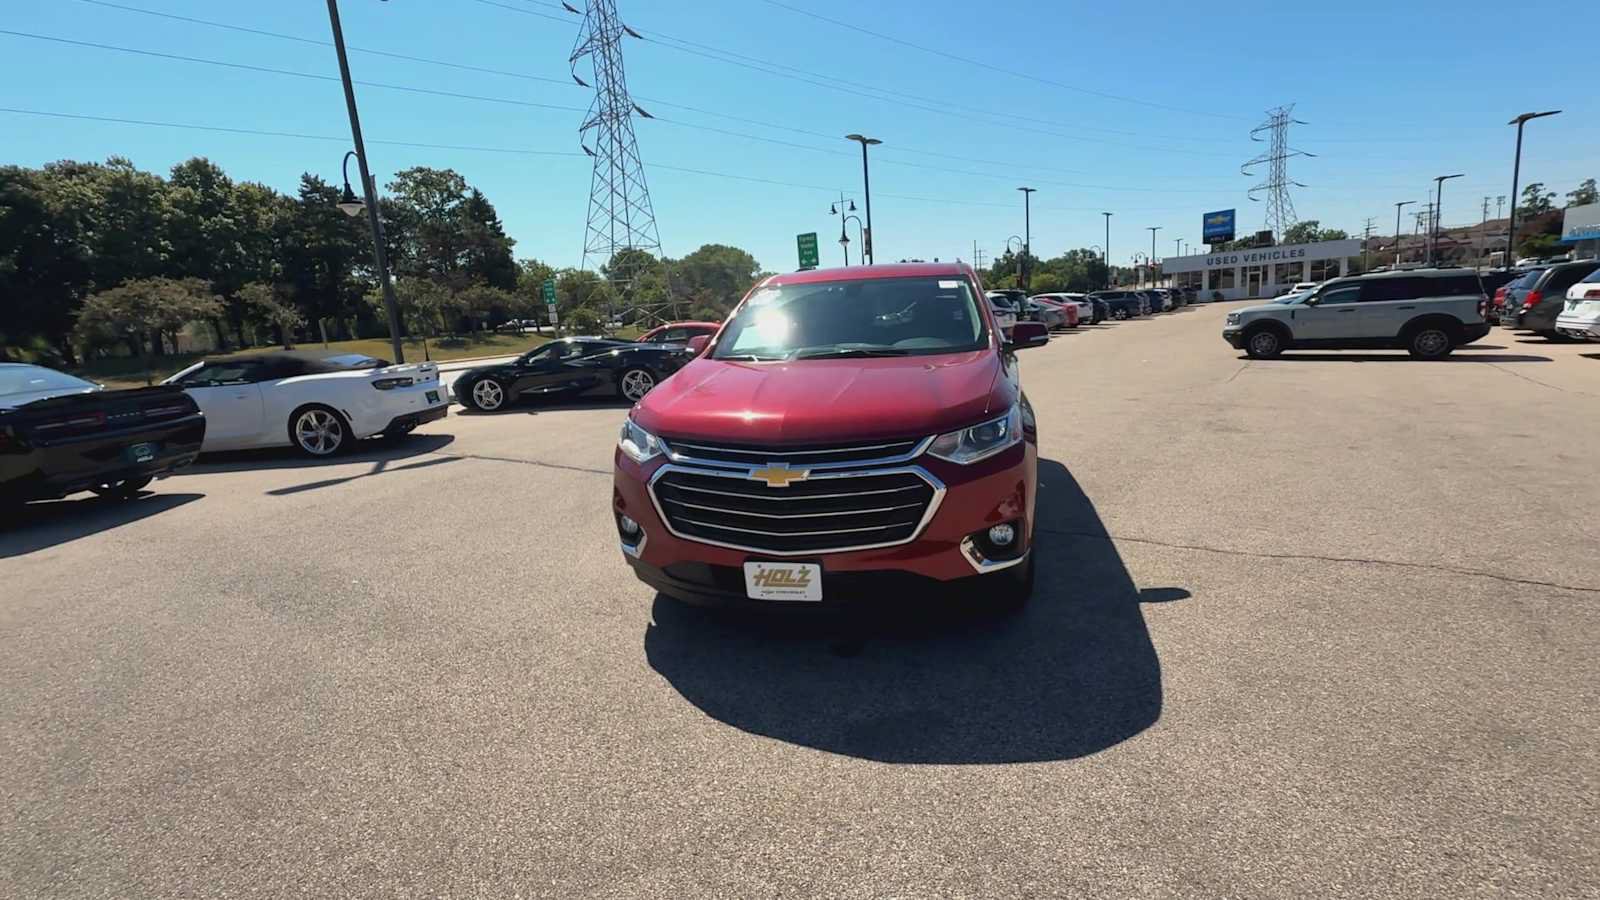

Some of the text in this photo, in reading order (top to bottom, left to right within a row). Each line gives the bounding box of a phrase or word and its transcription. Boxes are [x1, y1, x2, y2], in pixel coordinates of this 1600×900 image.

[1206, 248, 1305, 266] USED VEHICLES
[753, 569, 812, 587] HOLZ
